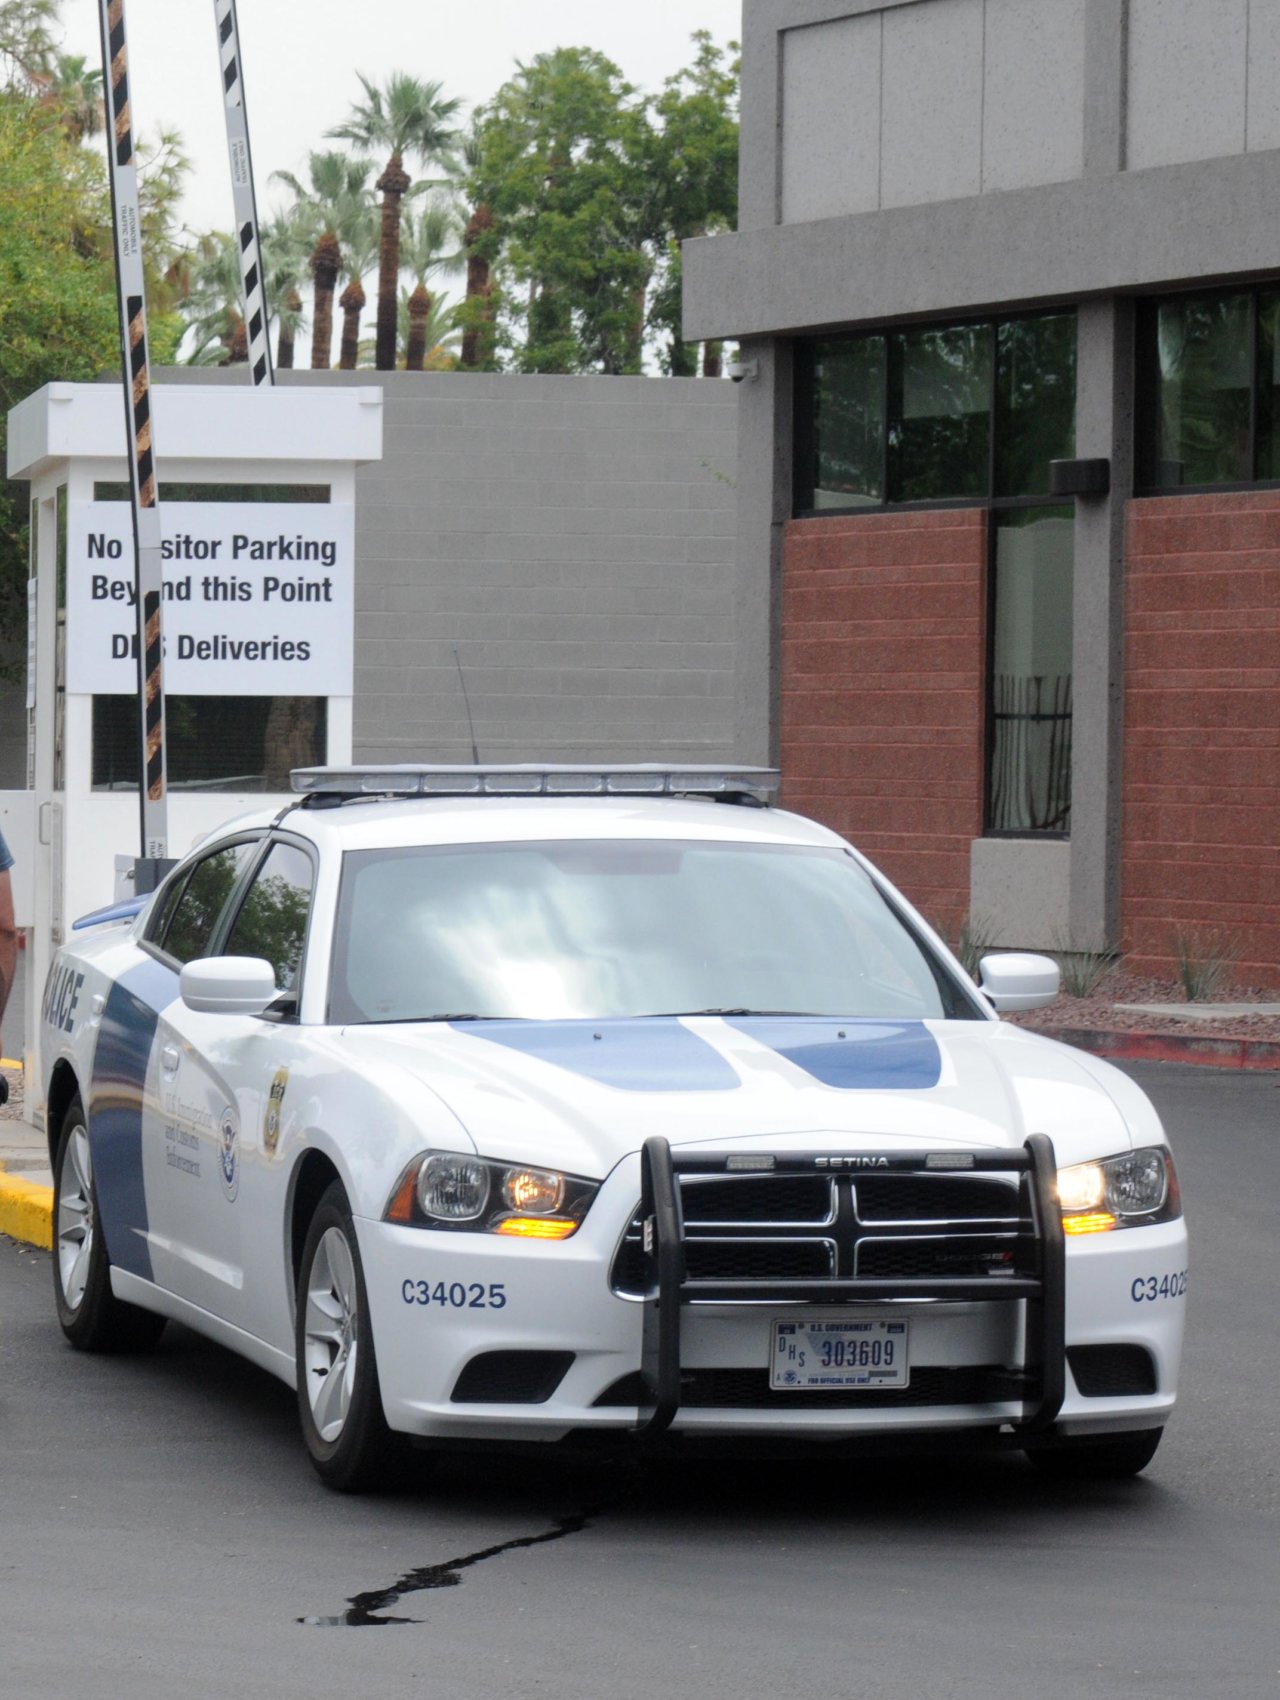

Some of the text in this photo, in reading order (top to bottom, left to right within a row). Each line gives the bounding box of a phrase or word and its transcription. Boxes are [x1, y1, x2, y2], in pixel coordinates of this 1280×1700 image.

[120, 205, 129, 236] TRAFFIC
[128, 207, 138, 254] AUTOMOBILE
[87, 533, 337, 567] No sitor Parking
[91, 575, 332, 605] Beynd this Point
[177, 634, 311, 661] Deliveries
[814, 1157, 889, 1167] SETINA
[402, 1278, 507, 1309] C34025
[825, 1322, 872, 1332] GOVERNMENT
[821, 1340, 894, 1367] 303609
